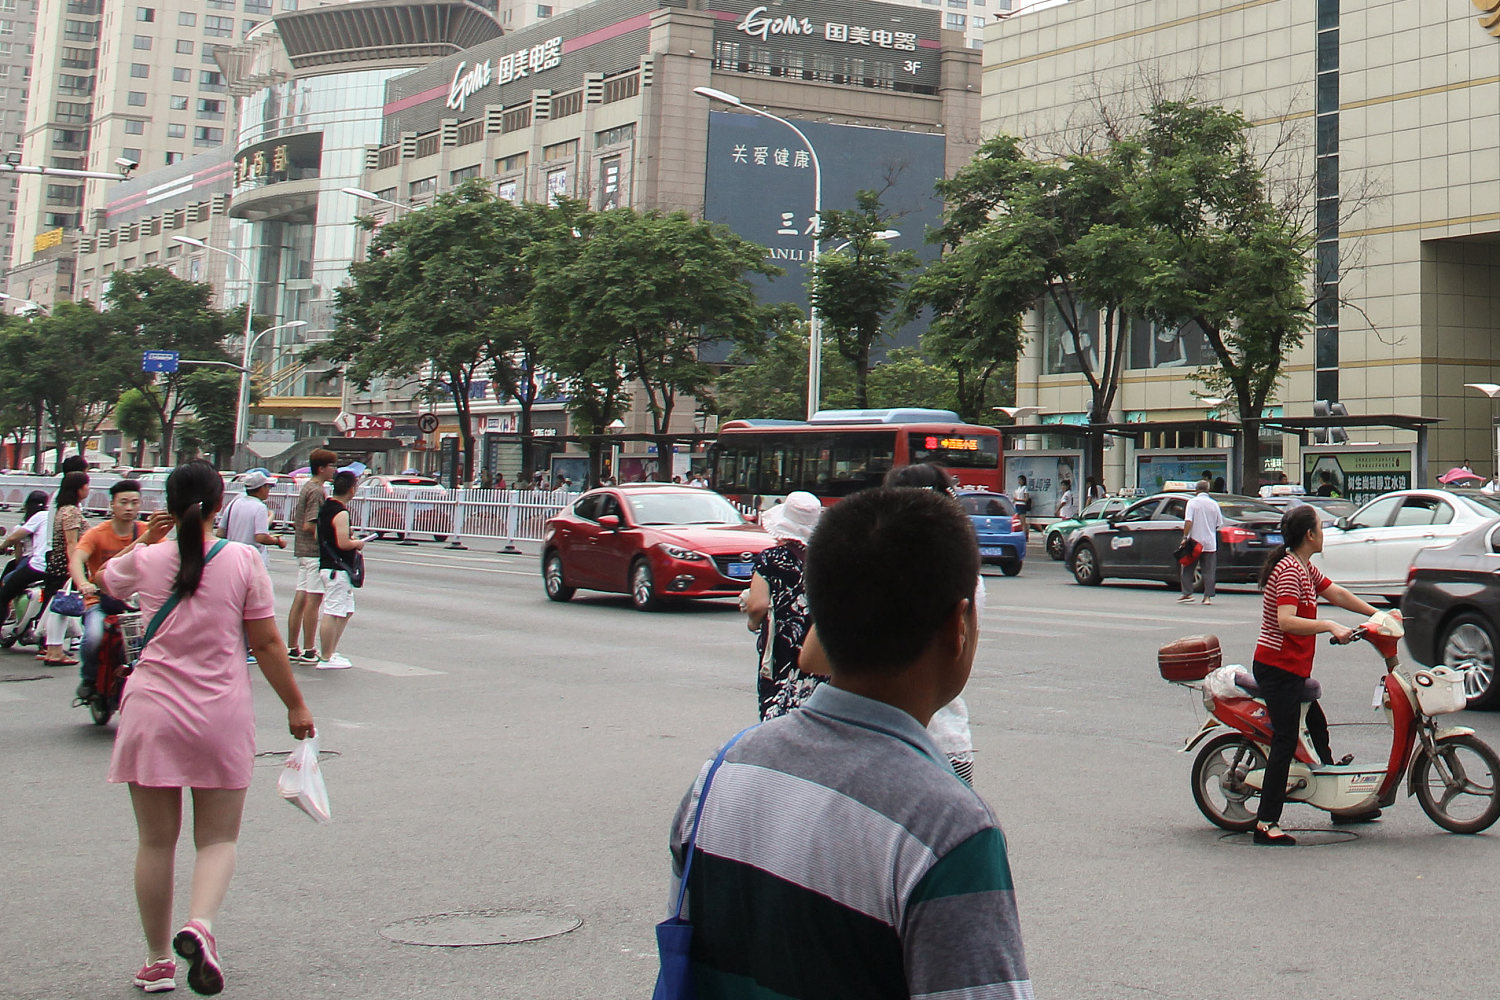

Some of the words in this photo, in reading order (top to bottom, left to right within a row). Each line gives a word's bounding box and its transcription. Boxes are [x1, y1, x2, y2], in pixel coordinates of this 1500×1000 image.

[824, 22, 917, 51] 国美电器
[498, 36, 563, 85] 国美电器
[903, 60, 922, 75] 3F
[732, 143, 810, 169] 关爱健康
